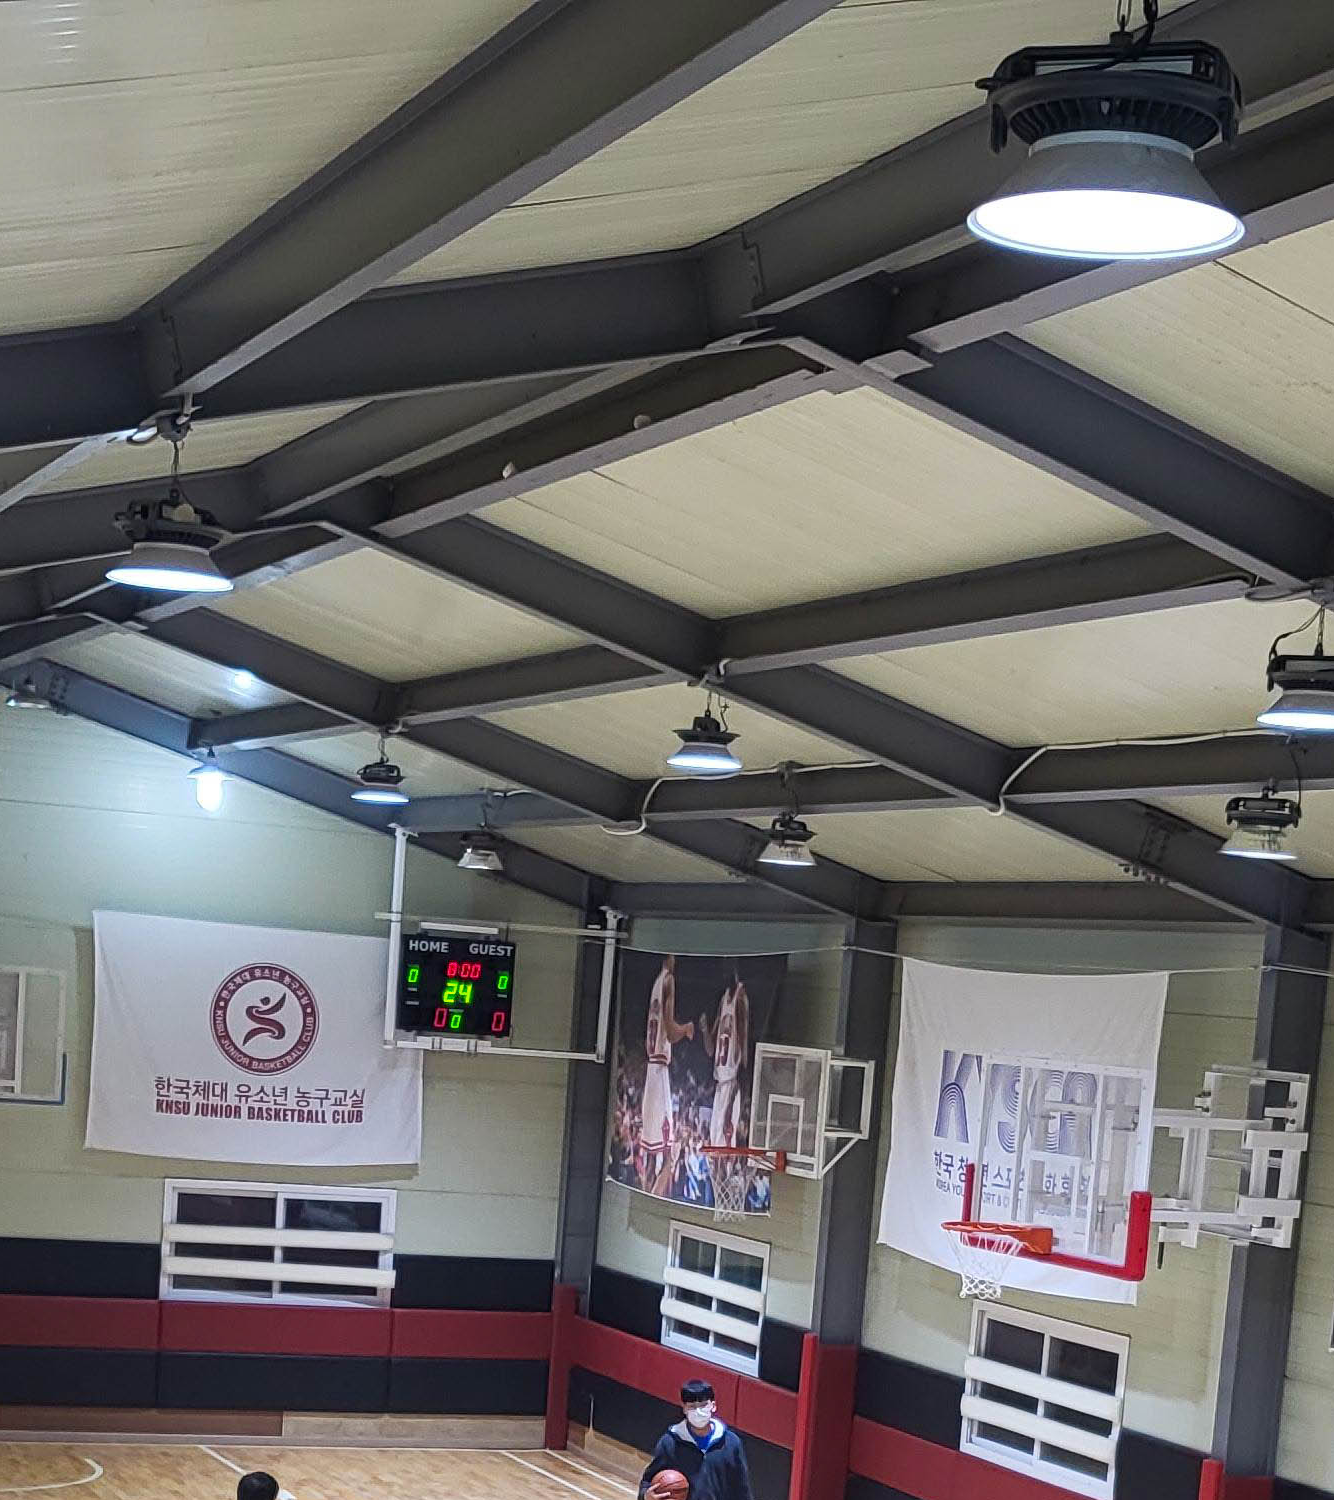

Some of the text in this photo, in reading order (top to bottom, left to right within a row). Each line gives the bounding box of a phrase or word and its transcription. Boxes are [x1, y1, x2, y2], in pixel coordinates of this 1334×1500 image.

[409, 940, 514, 957] HOME GUEST
[408, 968, 419, 983] 0
[497, 975, 509, 990] 0
[443, 982, 472, 1004] 24
[252, 1045, 307, 1070] BASKETBALL
[154, 1076, 365, 1109] 한국체대 유소년 농구교실
[156, 1099, 363, 1124] KNSU JUNIOR BASKETBALL CLUB
